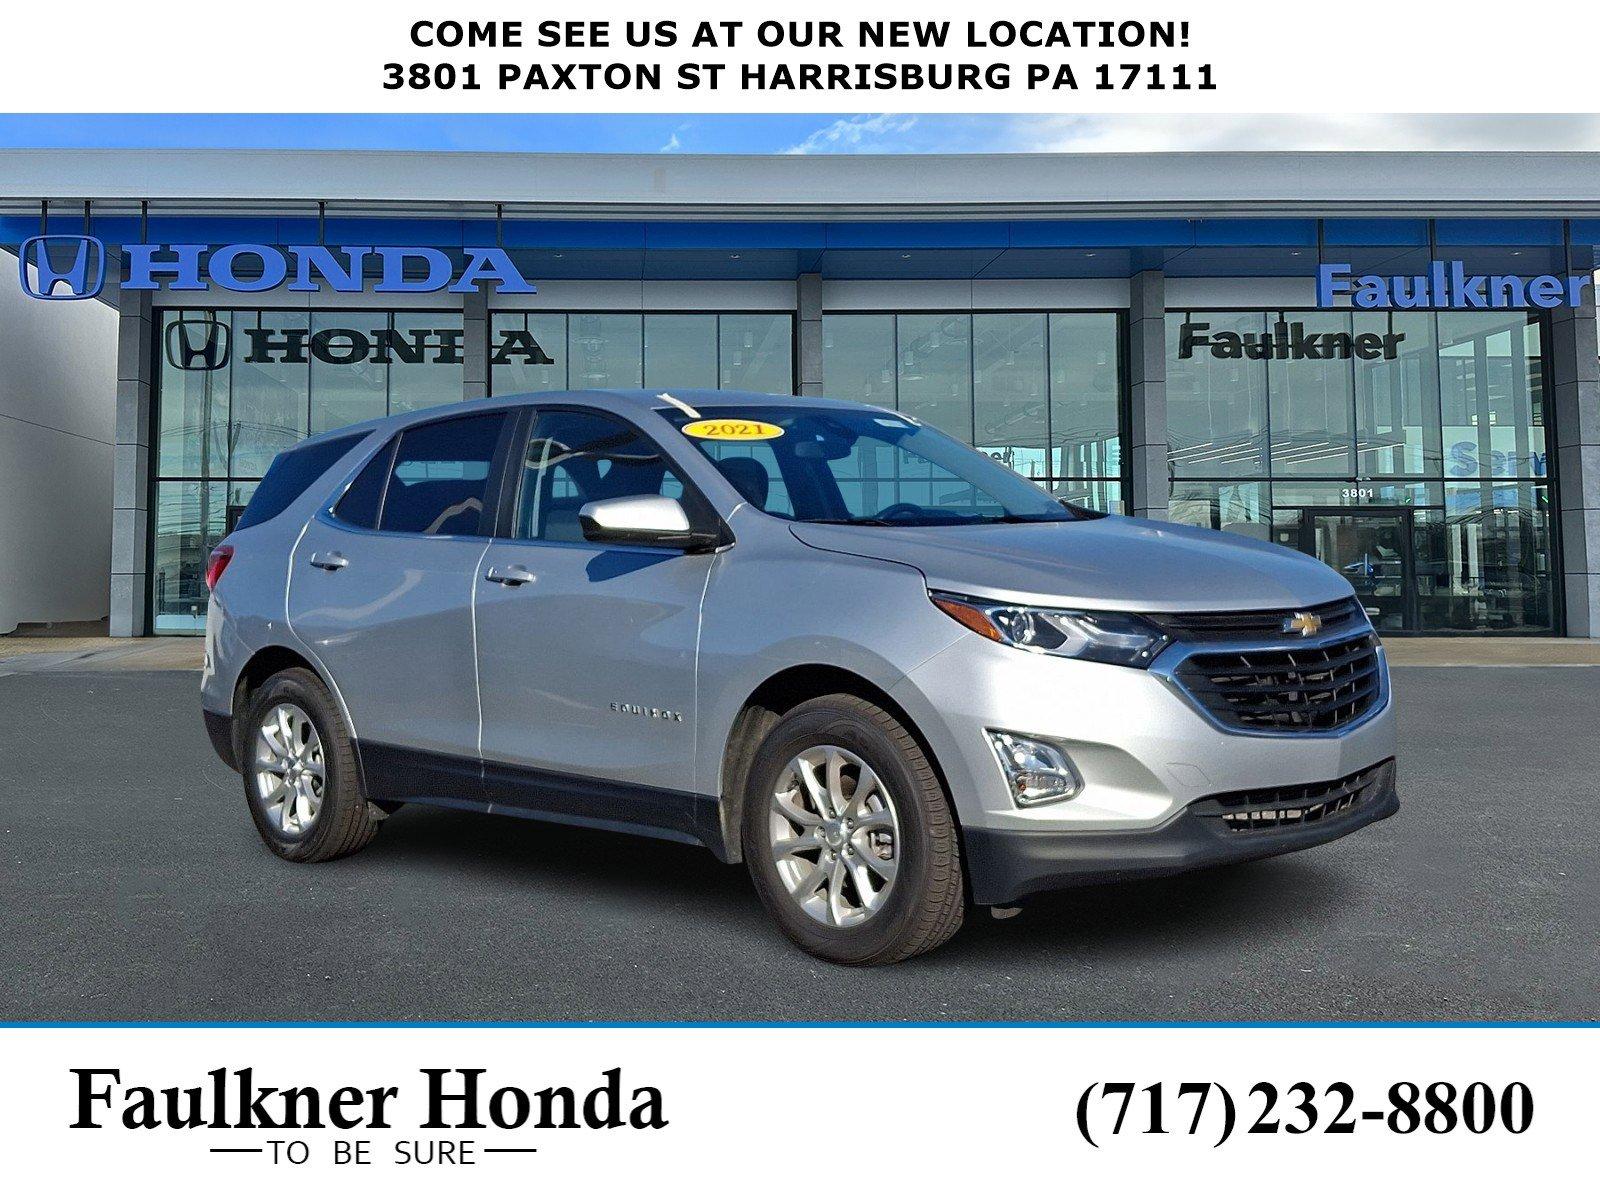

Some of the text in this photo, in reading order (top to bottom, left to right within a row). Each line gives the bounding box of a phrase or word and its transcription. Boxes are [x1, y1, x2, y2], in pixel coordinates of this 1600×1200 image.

[120, 244, 537, 294] HONDA
[1316, 260, 1592, 309] Faulkner
[1178, 321, 1406, 360] Faulkner
[702, 423, 765, 437] 2021
[1342, 488, 1373, 498] 3801
